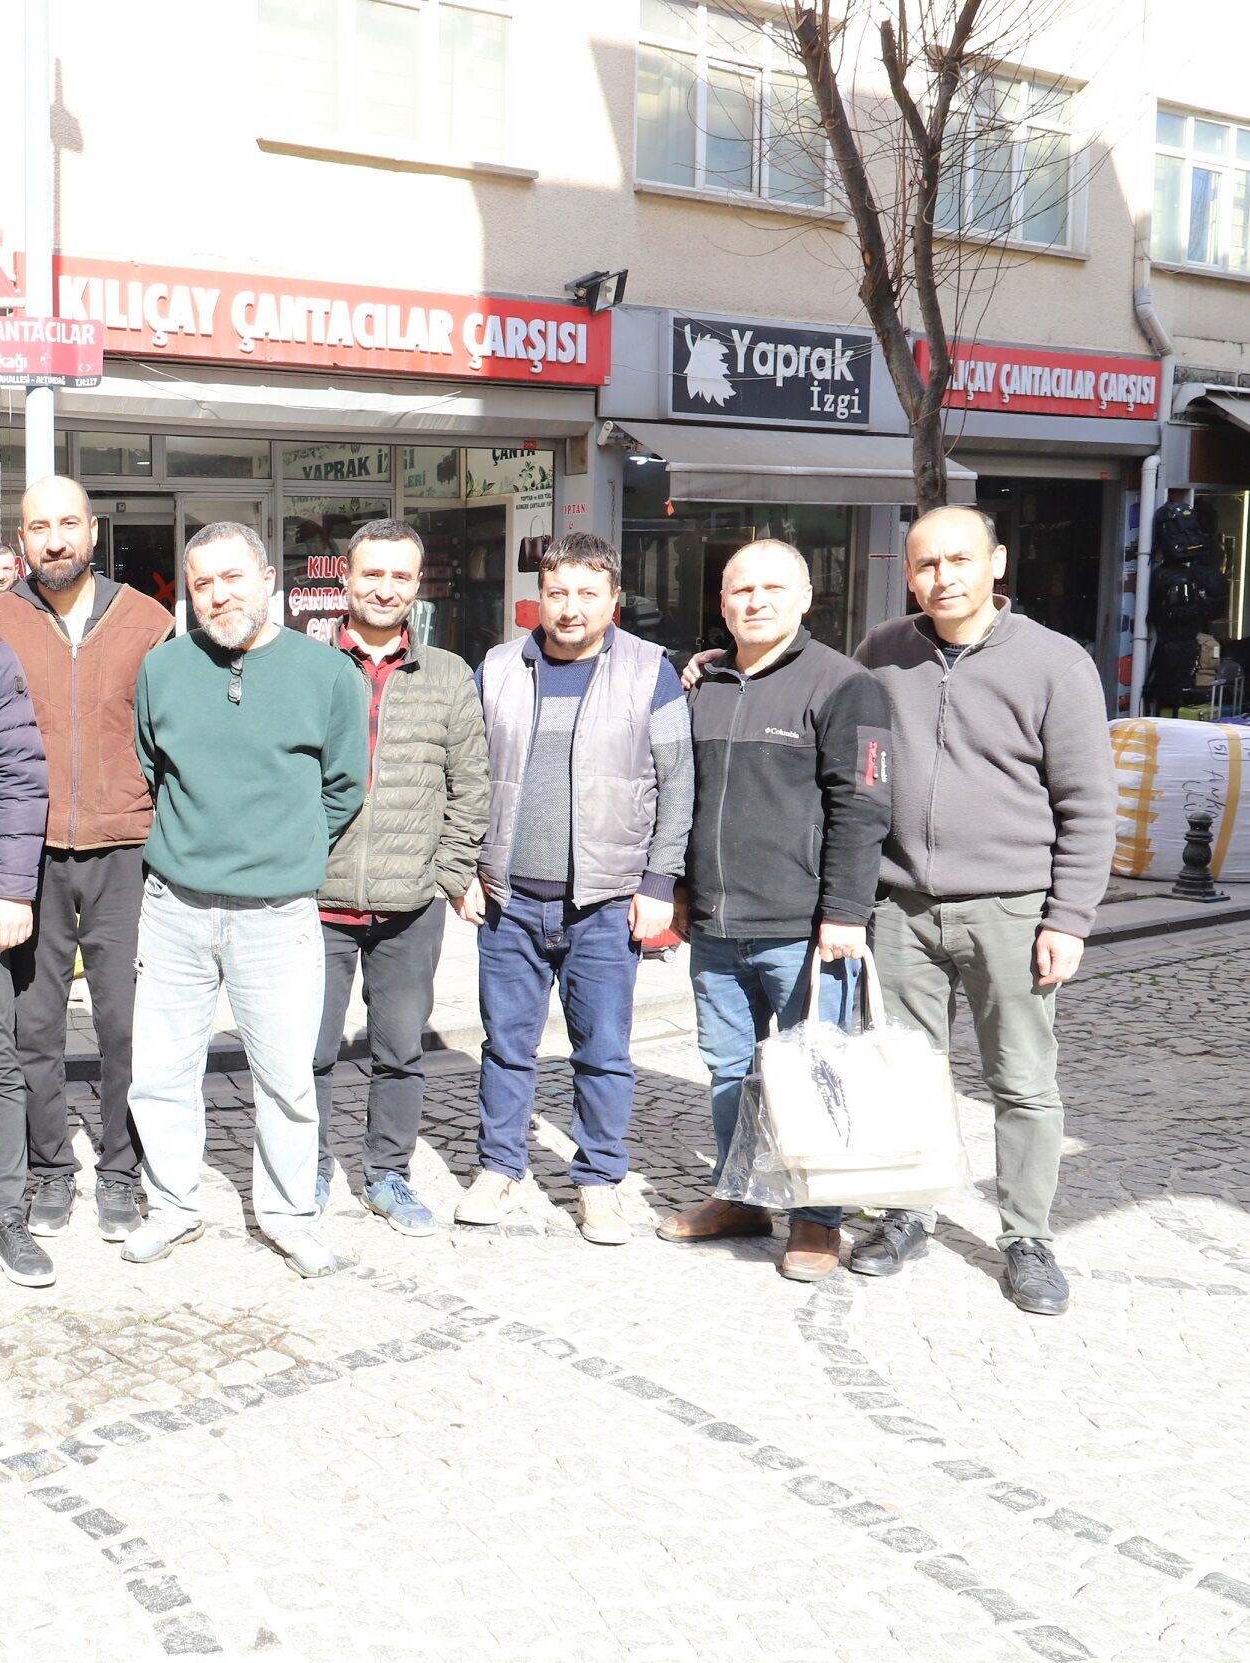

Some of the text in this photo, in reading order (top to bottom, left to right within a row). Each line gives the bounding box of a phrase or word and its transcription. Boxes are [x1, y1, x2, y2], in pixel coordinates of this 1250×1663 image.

[57, 274, 589, 374] KILIÇAY ÇANTACILAR ÇARŞISI
[731, 328, 854, 387] Yaprak
[810, 380, 862, 419] İzgi
[930, 357, 1156, 411] LIÇAY ÇANTACILAR ÇARŞISI
[302, 456, 371, 480] YAPRAK
[770, 727, 800, 739] Columbia
